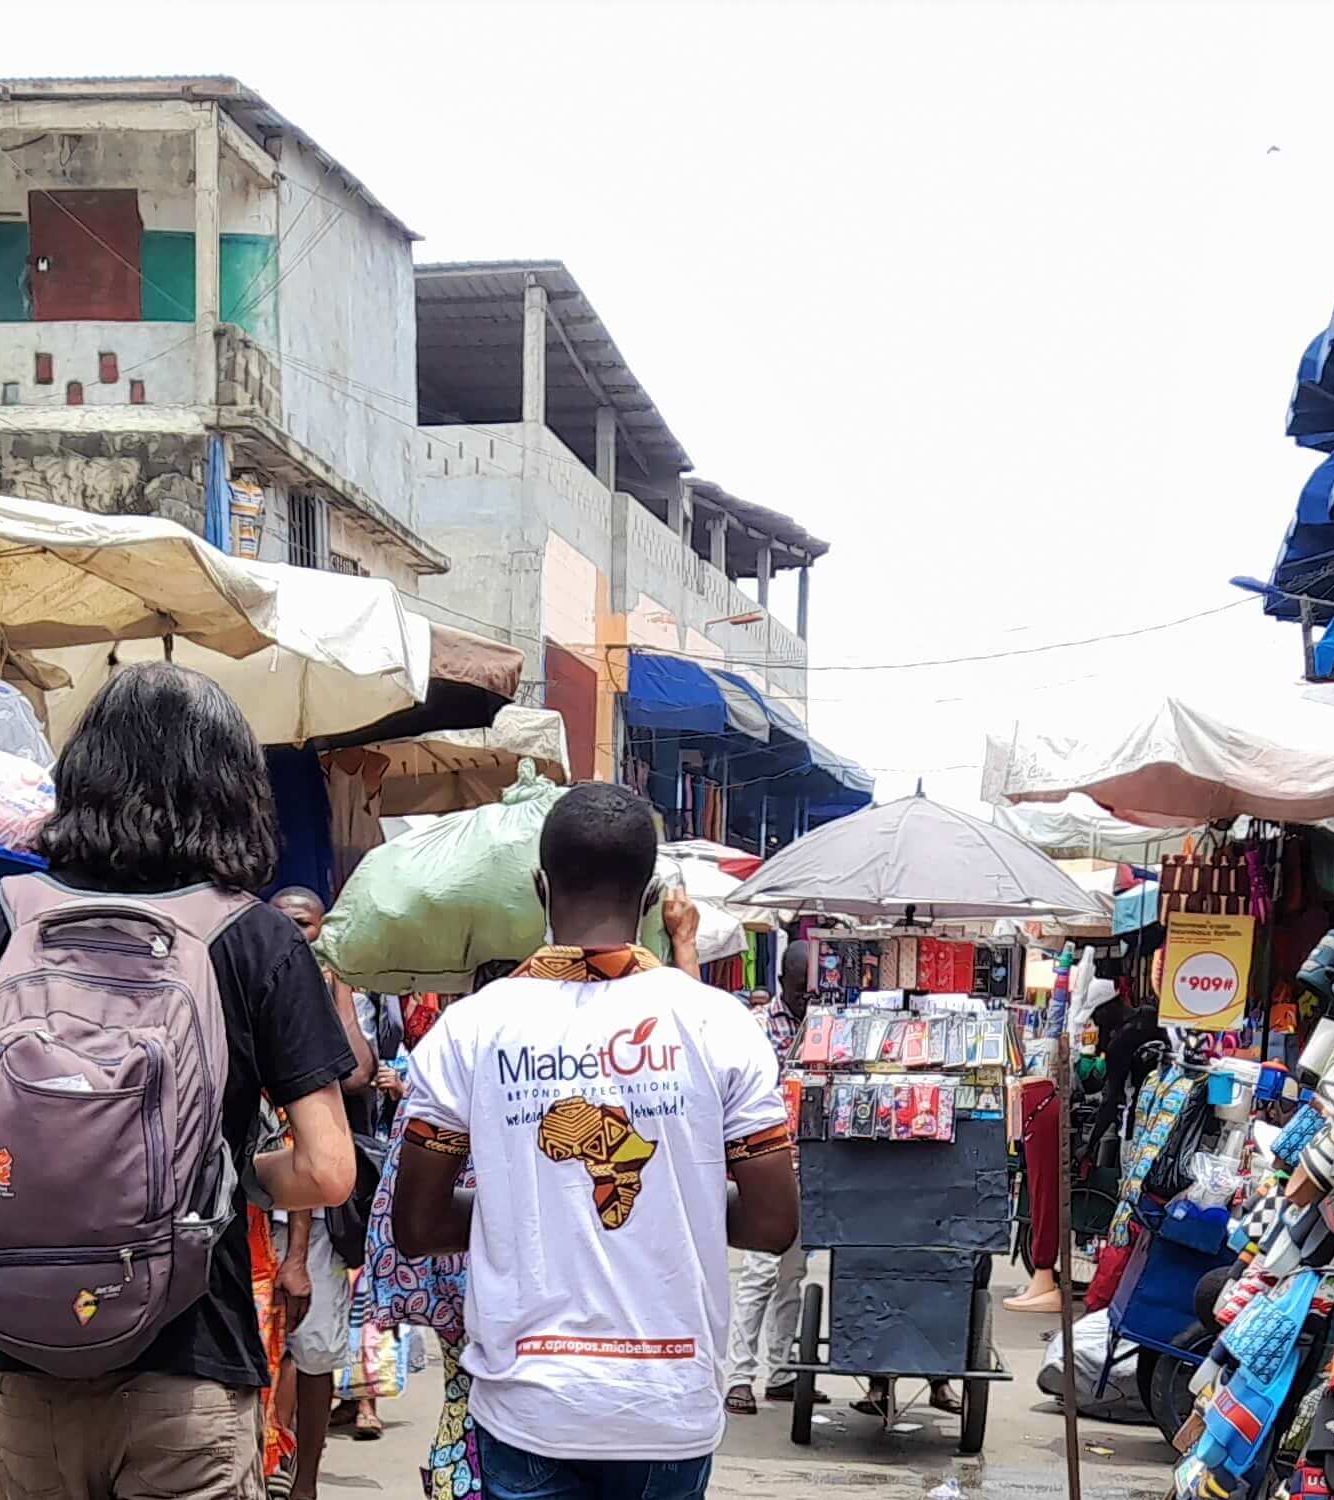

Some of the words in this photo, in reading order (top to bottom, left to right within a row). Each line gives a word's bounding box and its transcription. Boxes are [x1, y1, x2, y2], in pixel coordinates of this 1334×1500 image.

[507, 1088, 561, 1101] BEYOND
[571, 1080, 680, 1097] EXPECTATIONS
[629, 1095, 685, 1125] forward!
